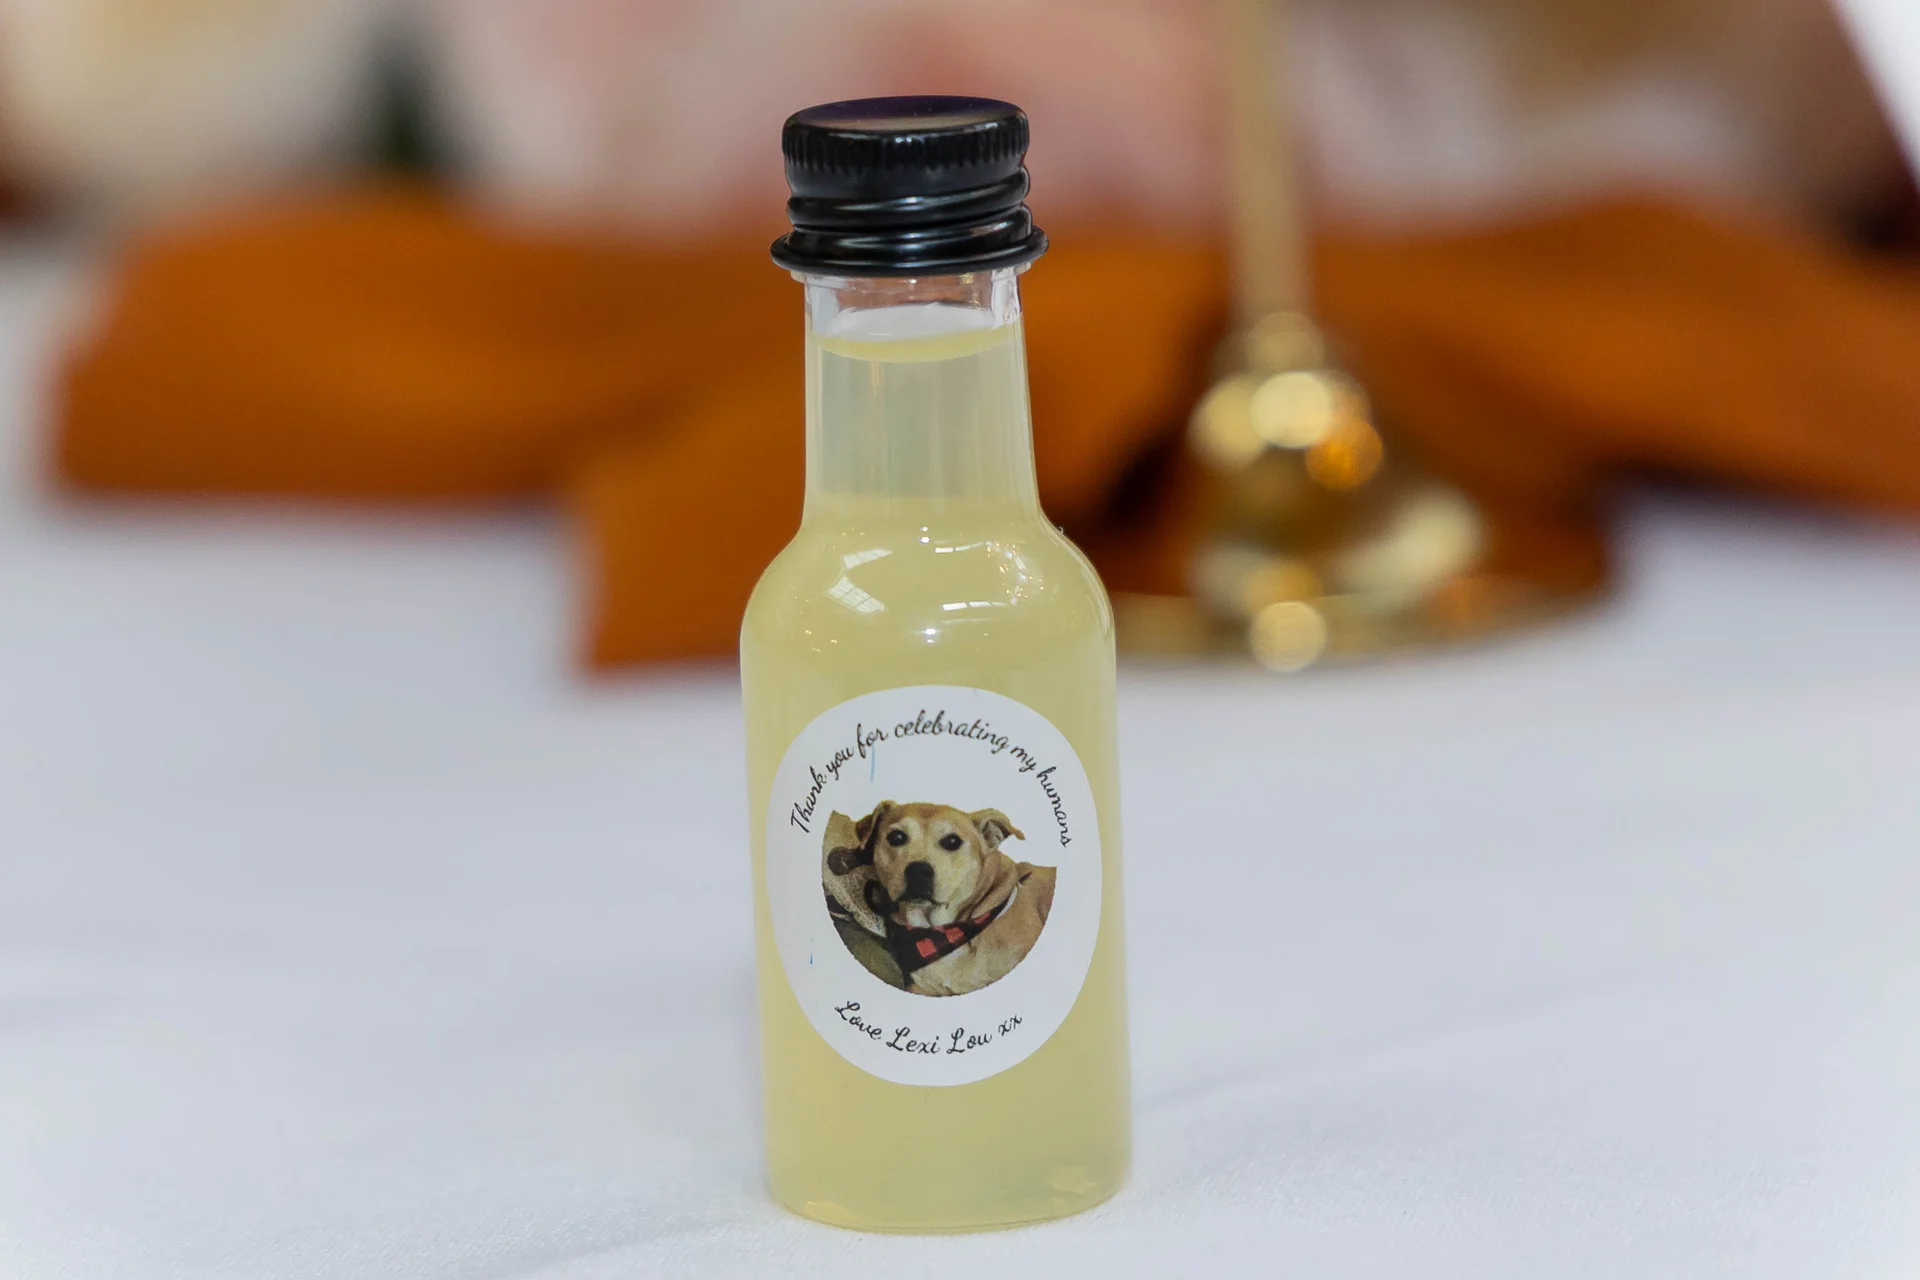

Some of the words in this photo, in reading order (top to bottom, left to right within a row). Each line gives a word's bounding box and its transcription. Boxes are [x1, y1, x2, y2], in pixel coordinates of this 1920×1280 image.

[790, 765, 828, 834] Thank
[826, 746, 856, 780] you
[856, 723, 889, 759] for
[894, 709, 1010, 755] celebrating
[1010, 745, 1038, 773] my
[1036, 766, 1072, 848] humans
[834, 1001, 882, 1040] Love
[885, 1026, 941, 1054] Lexi
[946, 1027, 993, 1054] Lou
[997, 1013, 1023, 1037] xx
